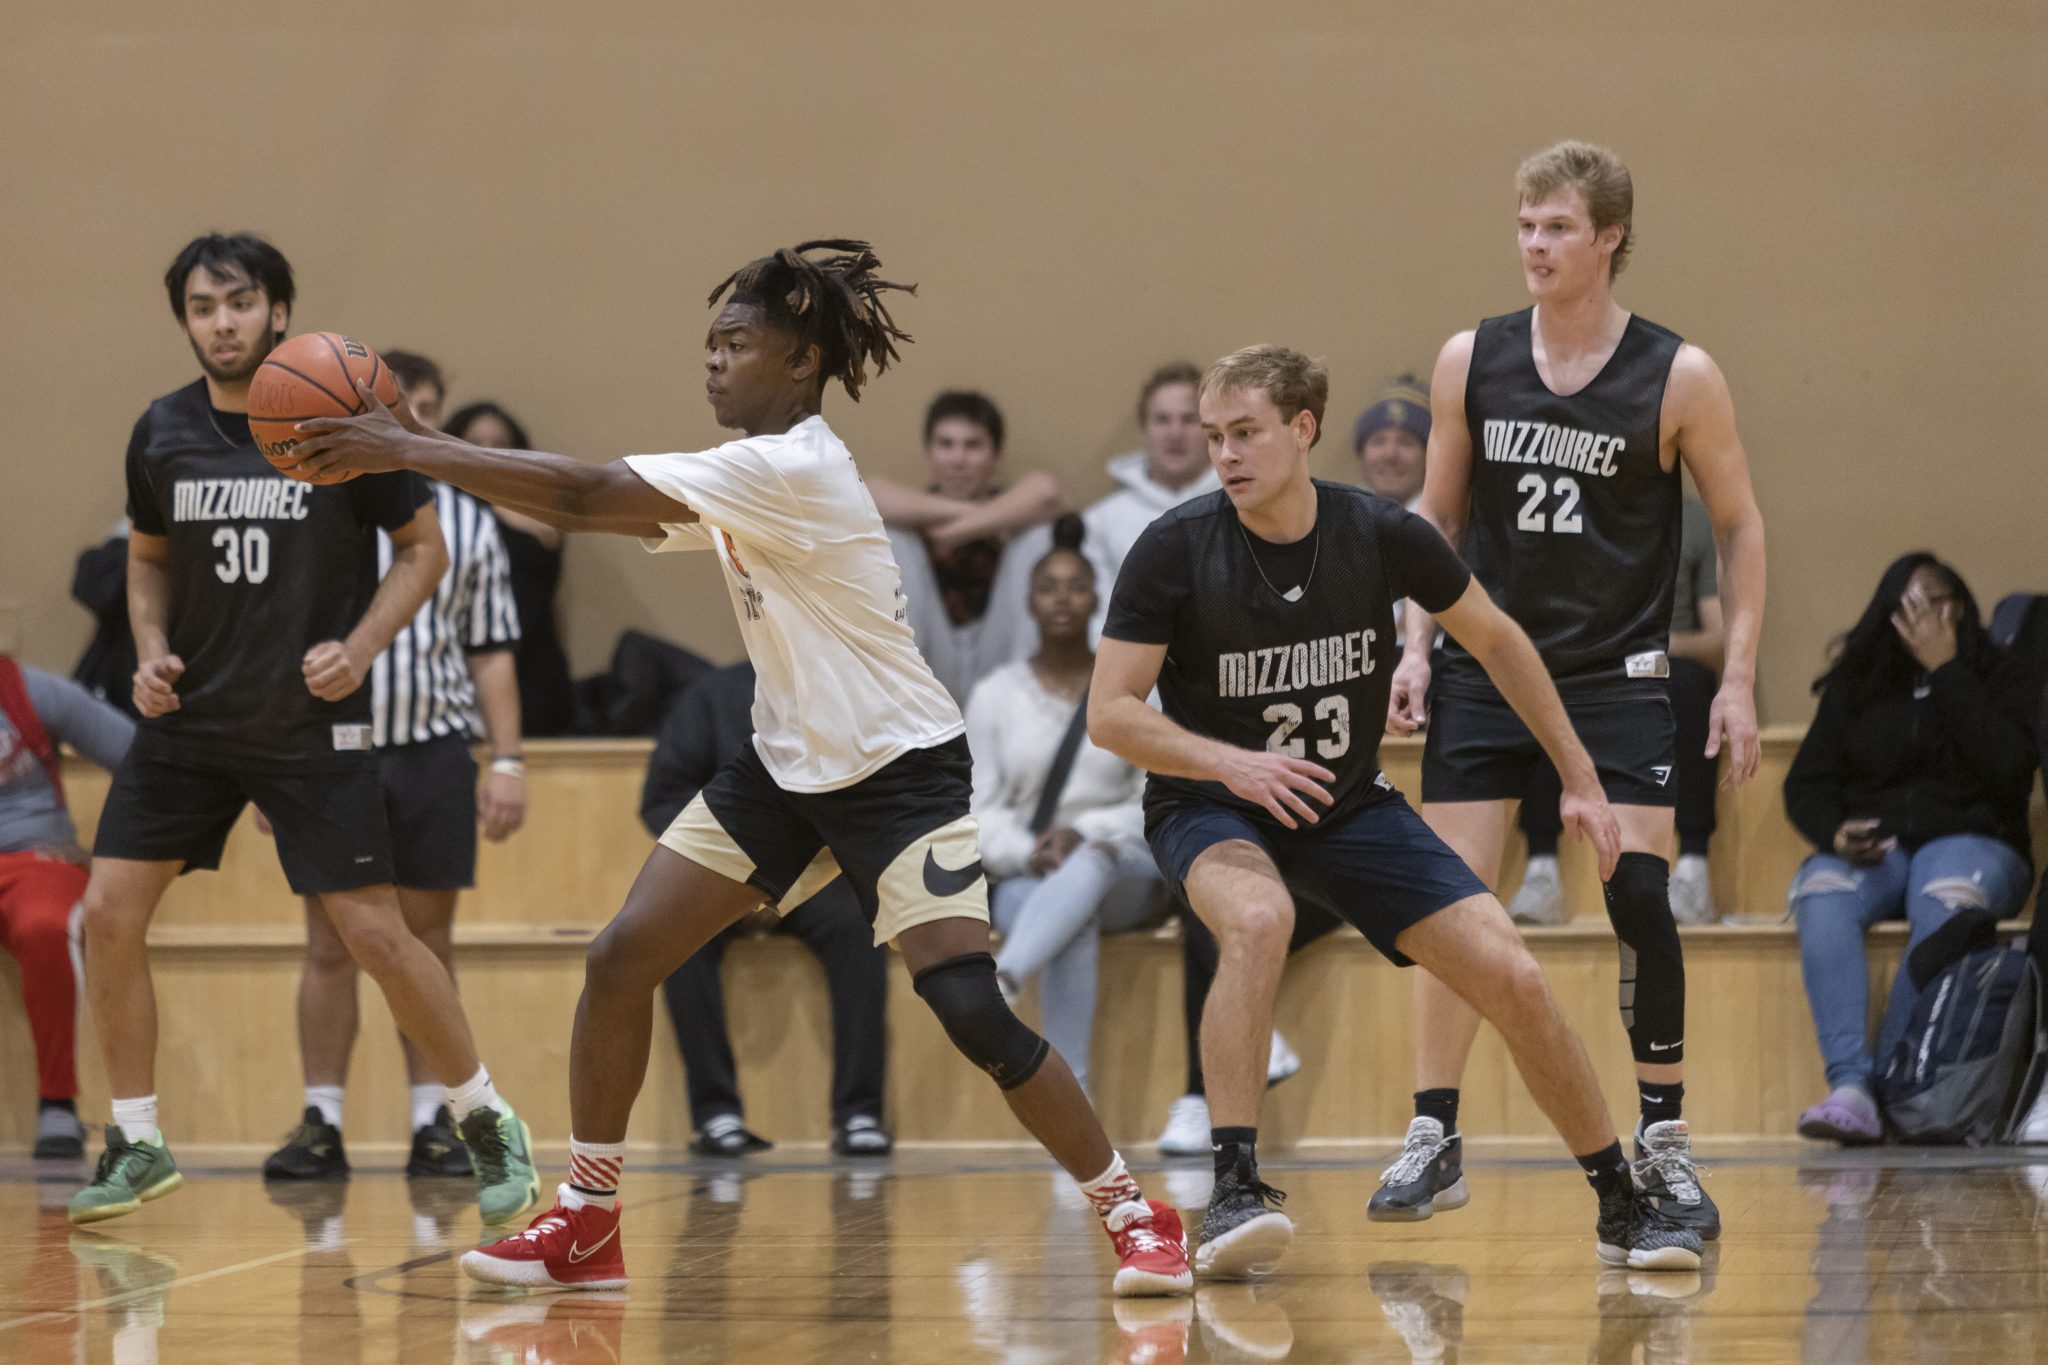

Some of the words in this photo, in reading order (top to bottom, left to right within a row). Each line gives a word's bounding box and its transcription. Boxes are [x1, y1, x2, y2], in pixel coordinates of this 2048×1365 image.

[1484, 419, 1626, 477] MIZZOUREC
[174, 478, 312, 521] MIZZOUREC
[1517, 473, 1583, 534] 22
[212, 525, 270, 584] 30
[1219, 628, 1377, 698] MIZZOUREC
[1262, 694, 1350, 760] 23
